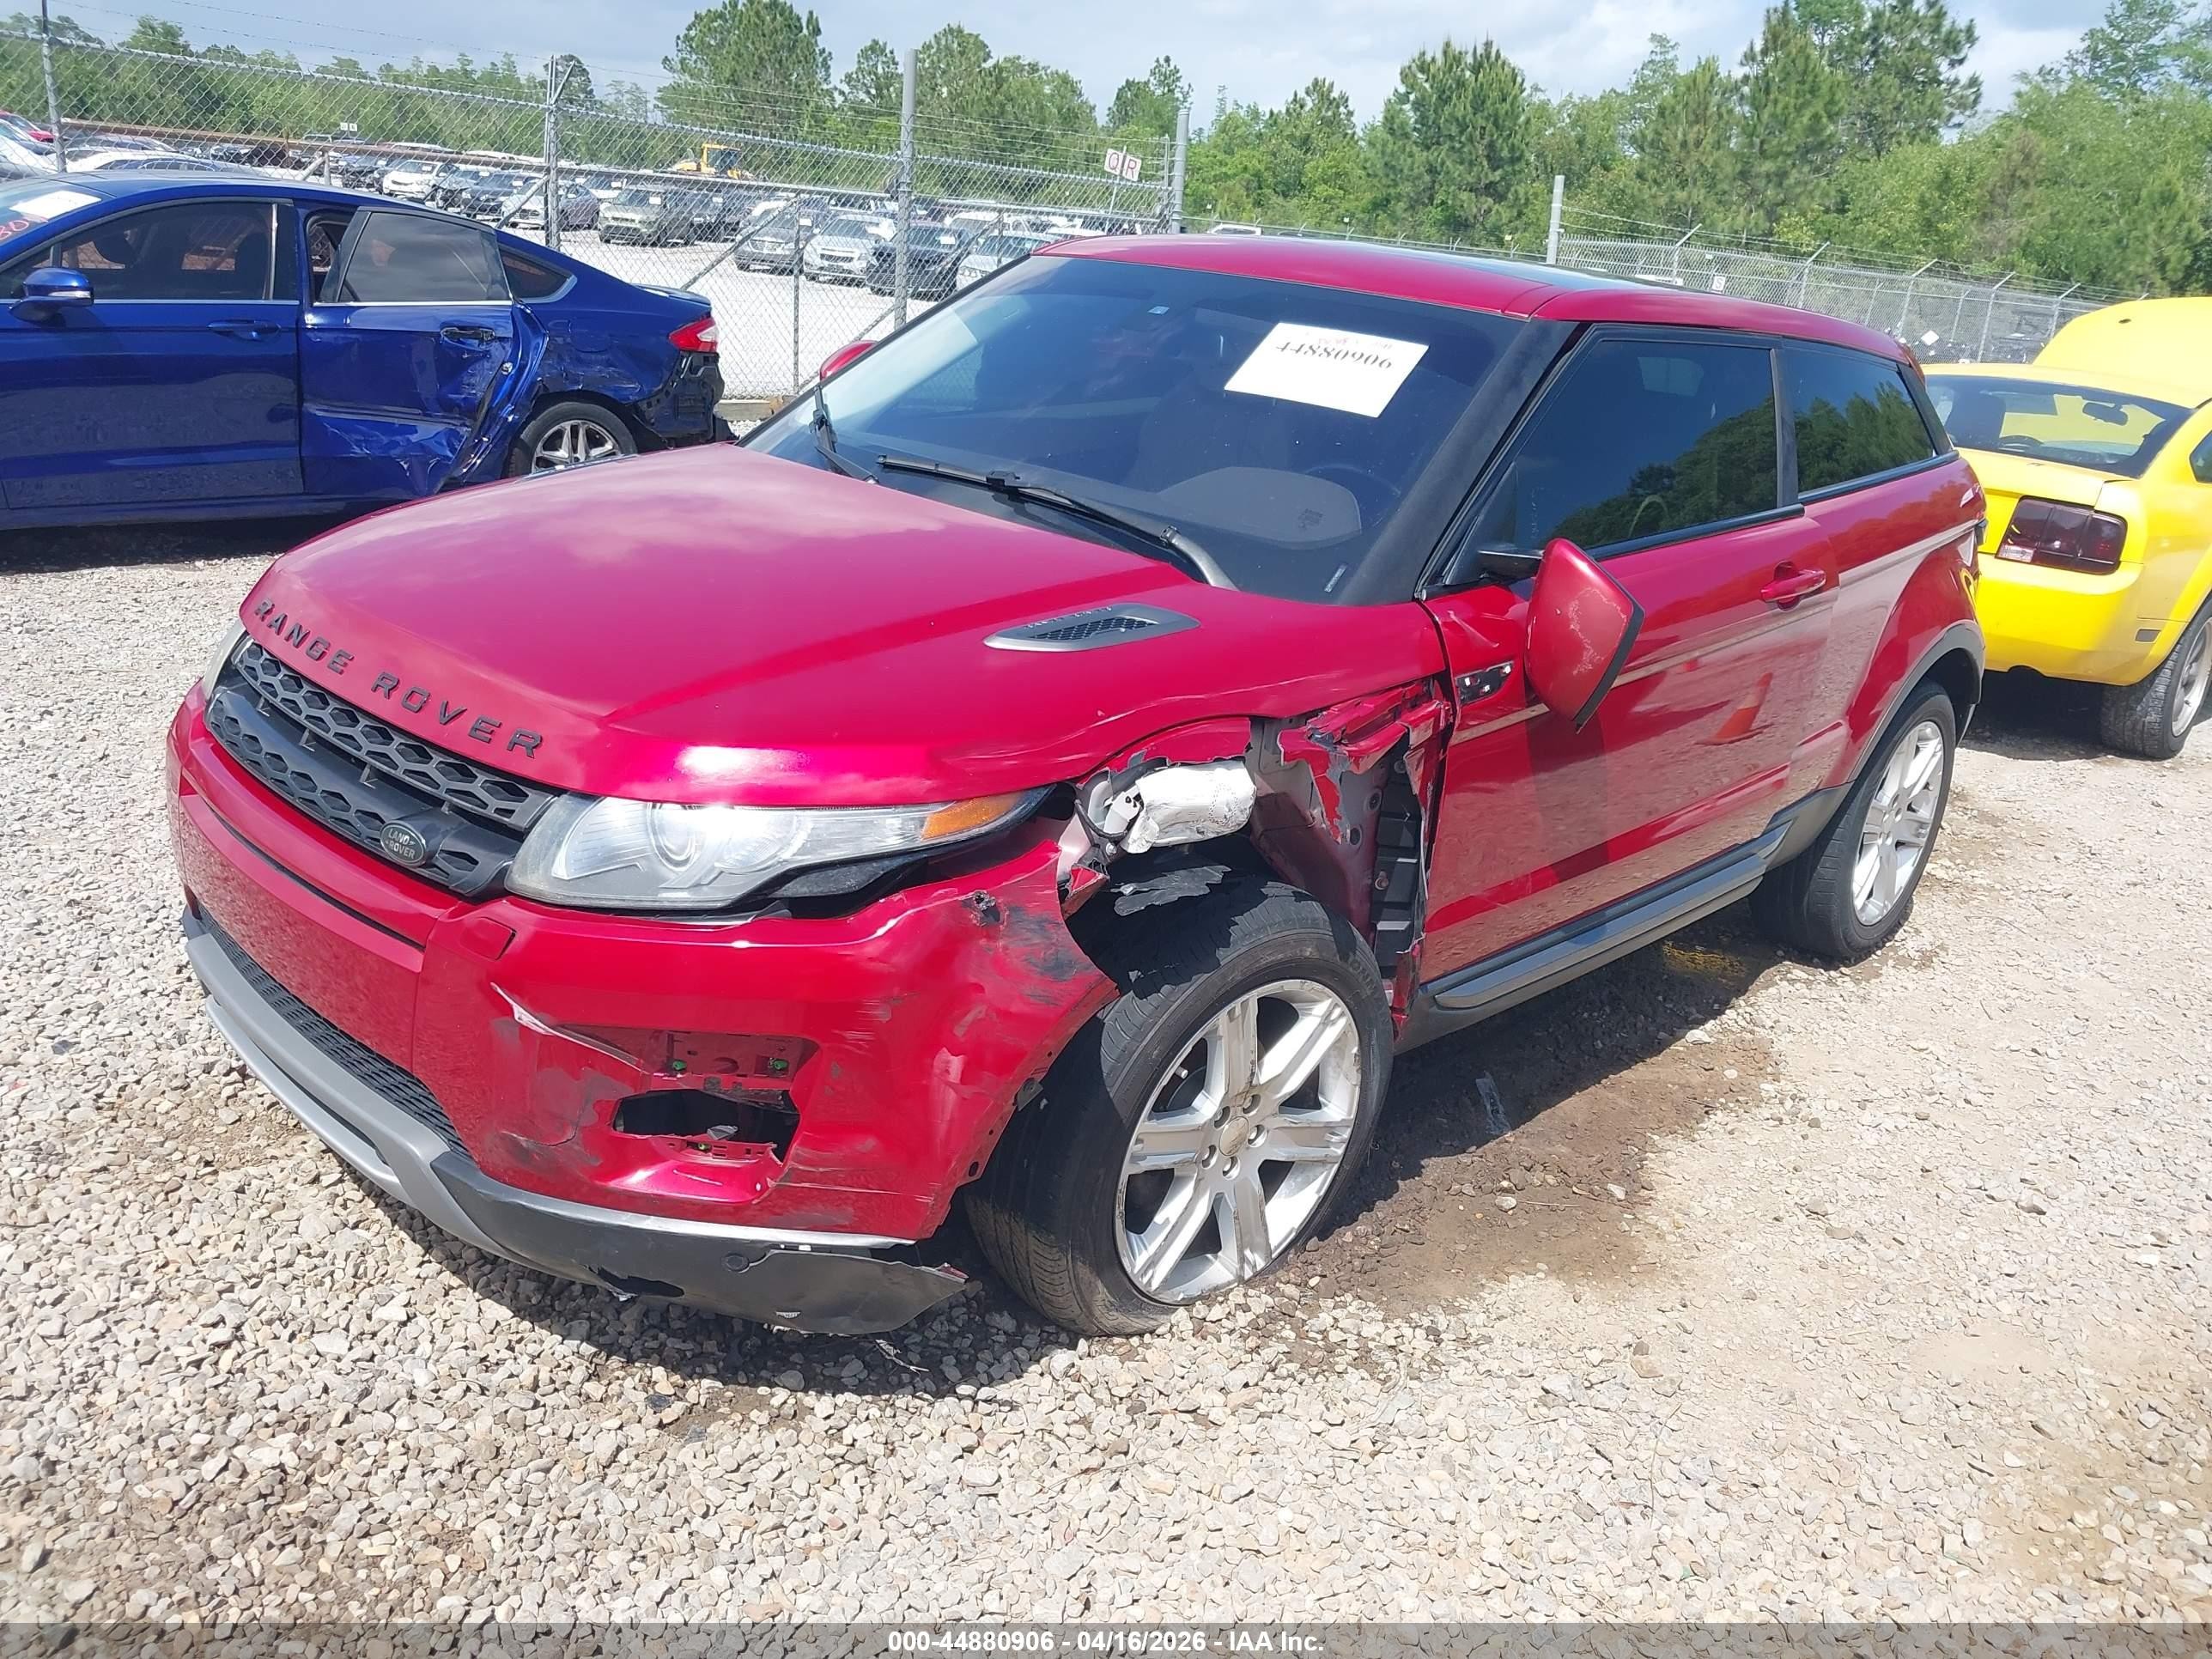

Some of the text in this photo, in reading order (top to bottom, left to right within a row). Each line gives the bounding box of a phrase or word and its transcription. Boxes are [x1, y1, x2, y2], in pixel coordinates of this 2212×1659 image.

[1126, 159, 1137, 179] R
[1276, 342, 1392, 369] 44880906
[254, 598, 543, 759] RANGE ROVER
[388, 828, 410, 846] LAND
[389, 841, 416, 860] ROVER
